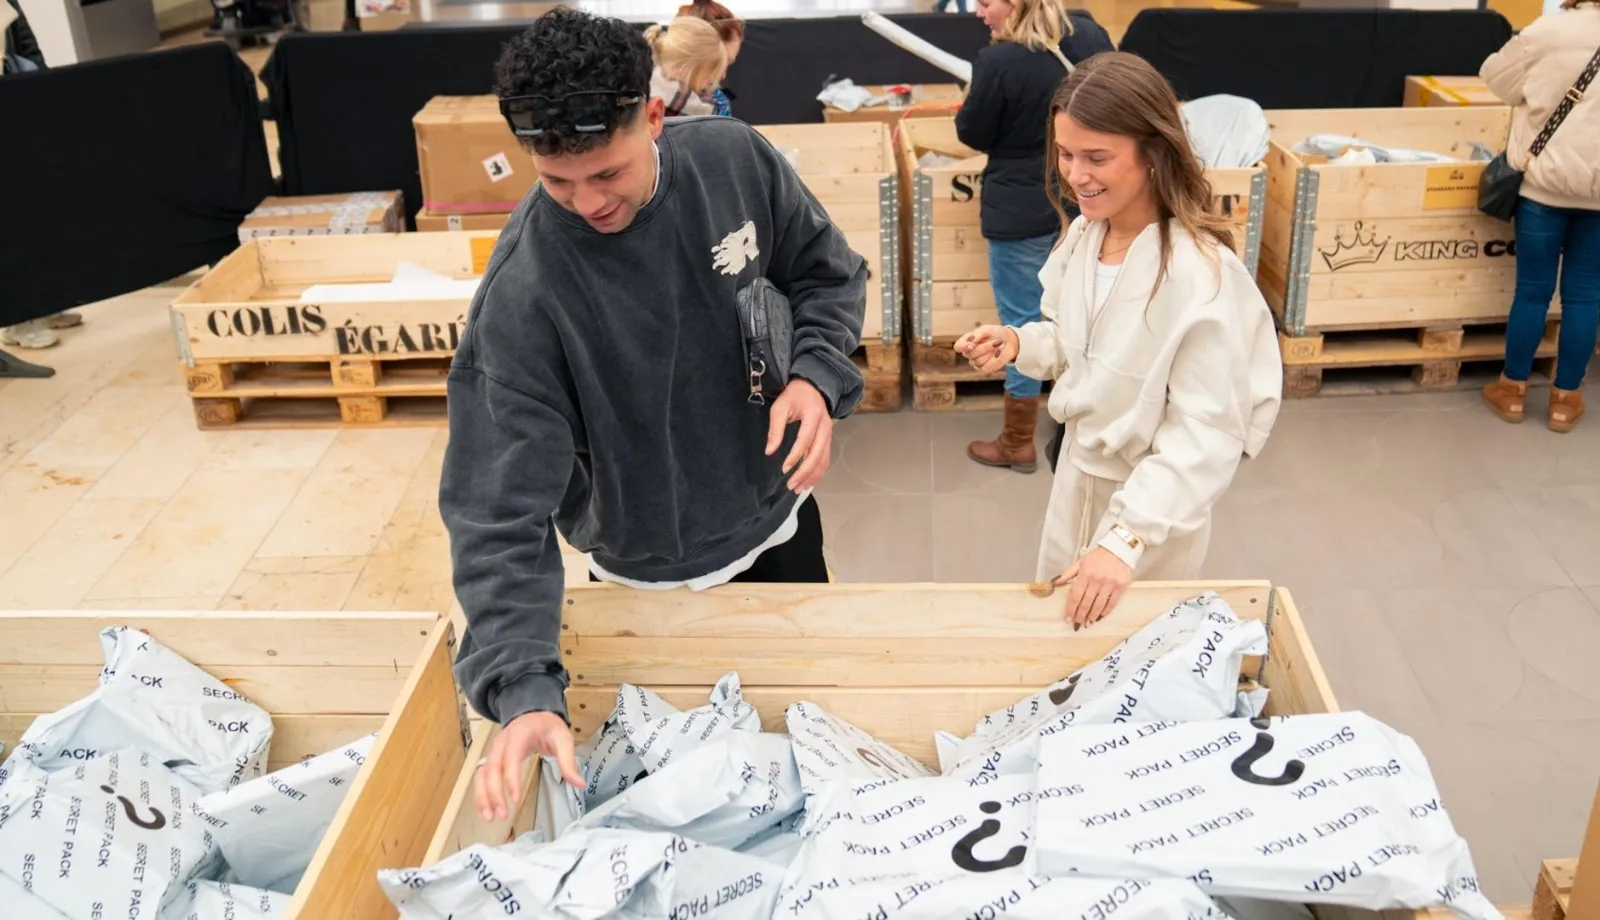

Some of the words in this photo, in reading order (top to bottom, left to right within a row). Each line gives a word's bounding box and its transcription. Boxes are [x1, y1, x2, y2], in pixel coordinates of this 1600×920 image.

[1395, 240, 1478, 260] KING
[207, 304, 327, 338] COLIS
[1192, 630, 1224, 679] PACK
[700, 716, 720, 741] SECRET
[1081, 735, 1130, 758] PACK
[1179, 730, 1242, 764] SECRET
[1124, 759, 1173, 780] PACK
[267, 775, 308, 802] SECRET
[1138, 785, 1206, 814] SECRET
[900, 814, 968, 850] SECRET
[1080, 808, 1131, 828] PACK
[1186, 807, 1254, 839] SECRET
[1312, 805, 1379, 838] SECRET
[1126, 833, 1179, 855] PACK
[1256, 832, 1309, 857] PACK
[59, 841, 74, 878] PACK
[134, 842, 148, 884] SECRET
[713, 871, 763, 909] SECRET
